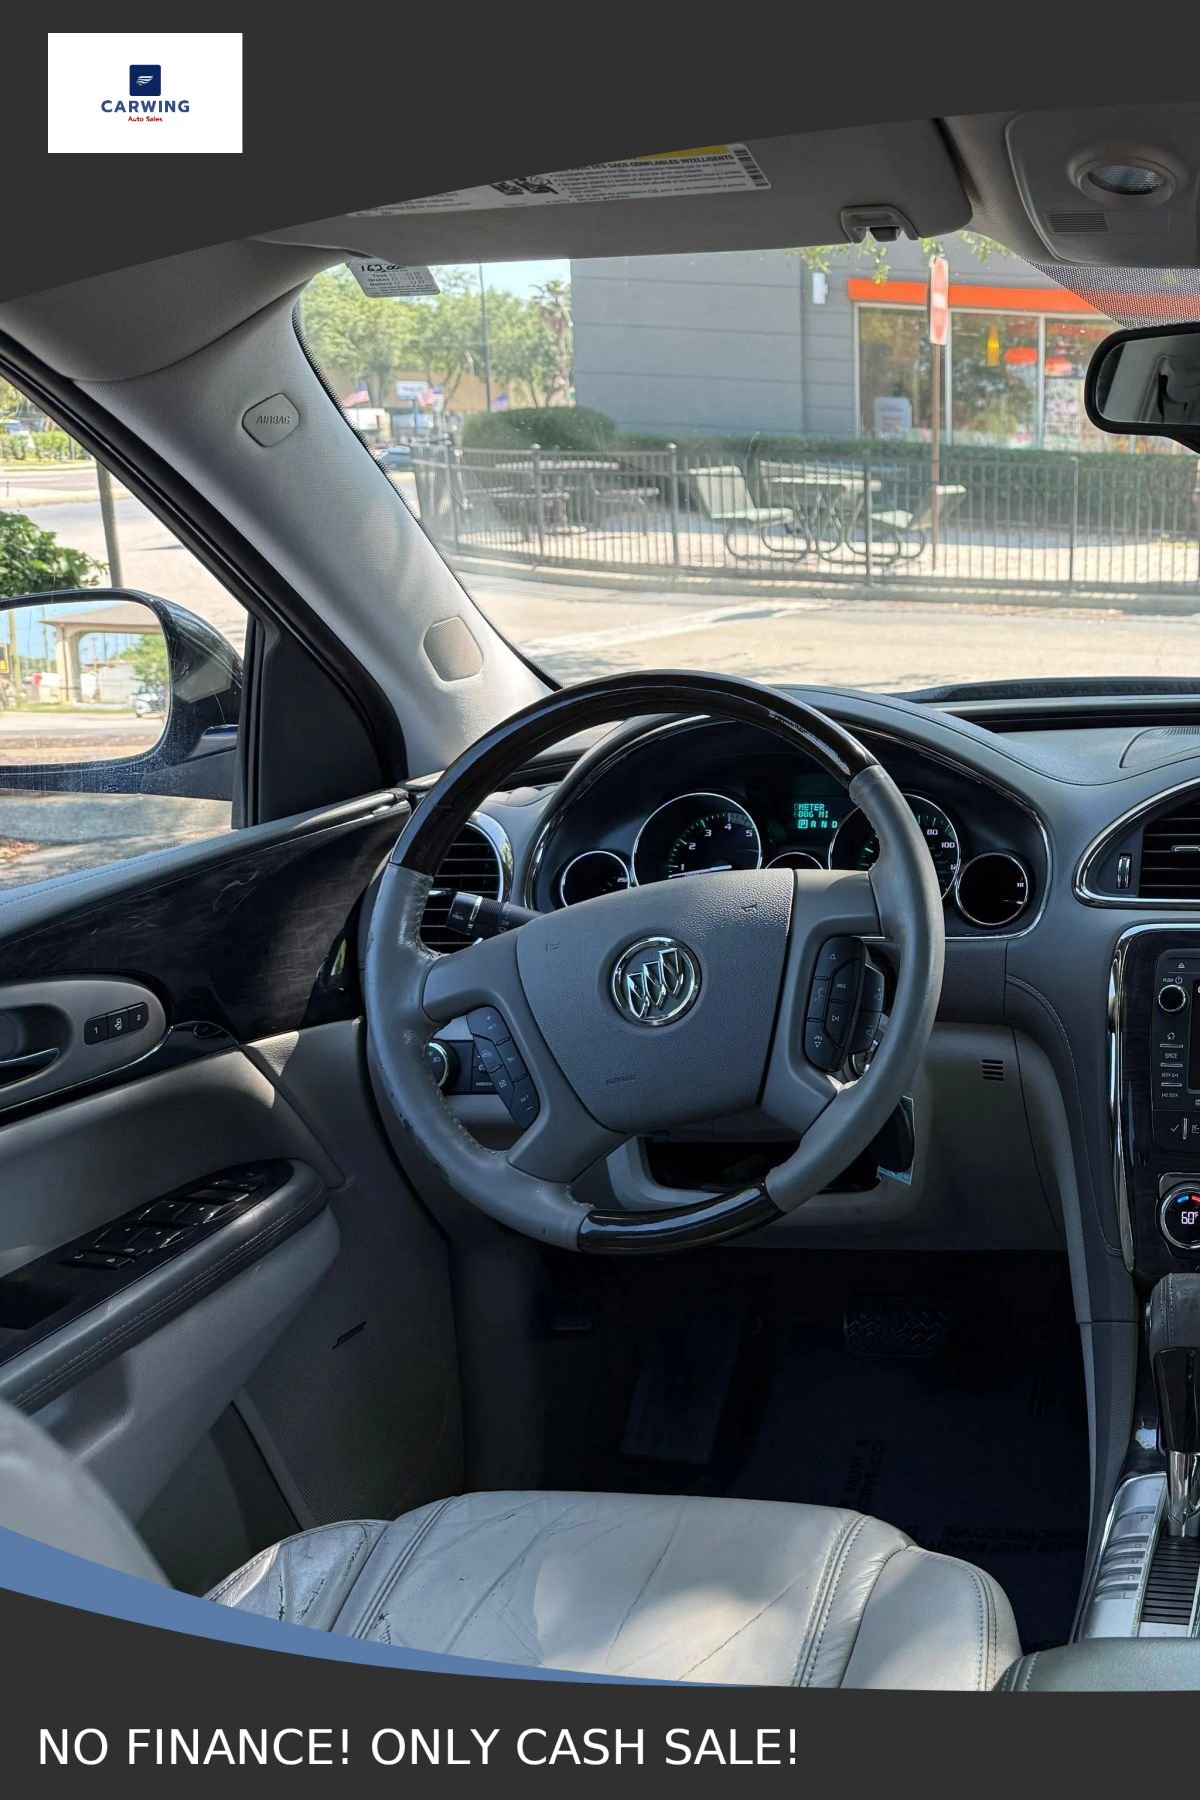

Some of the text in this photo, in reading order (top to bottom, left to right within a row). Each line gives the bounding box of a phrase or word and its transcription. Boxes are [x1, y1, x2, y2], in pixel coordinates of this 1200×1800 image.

[256, 415, 290, 424] AIRBAG
[724, 822, 733, 831] 4
[831, 820, 838, 828] D
[704, 828, 713, 837] 3
[744, 829, 753, 838] 5
[926, 828, 939, 836] 80
[688, 842, 697, 850] 2
[941, 841, 956, 849] 100
[94, 1026, 99, 1034] 1
[1164, 1052, 1178, 1060] SRCE
[1140, 1514, 1149, 1522] P
[1122, 1591, 1132, 1600] L
